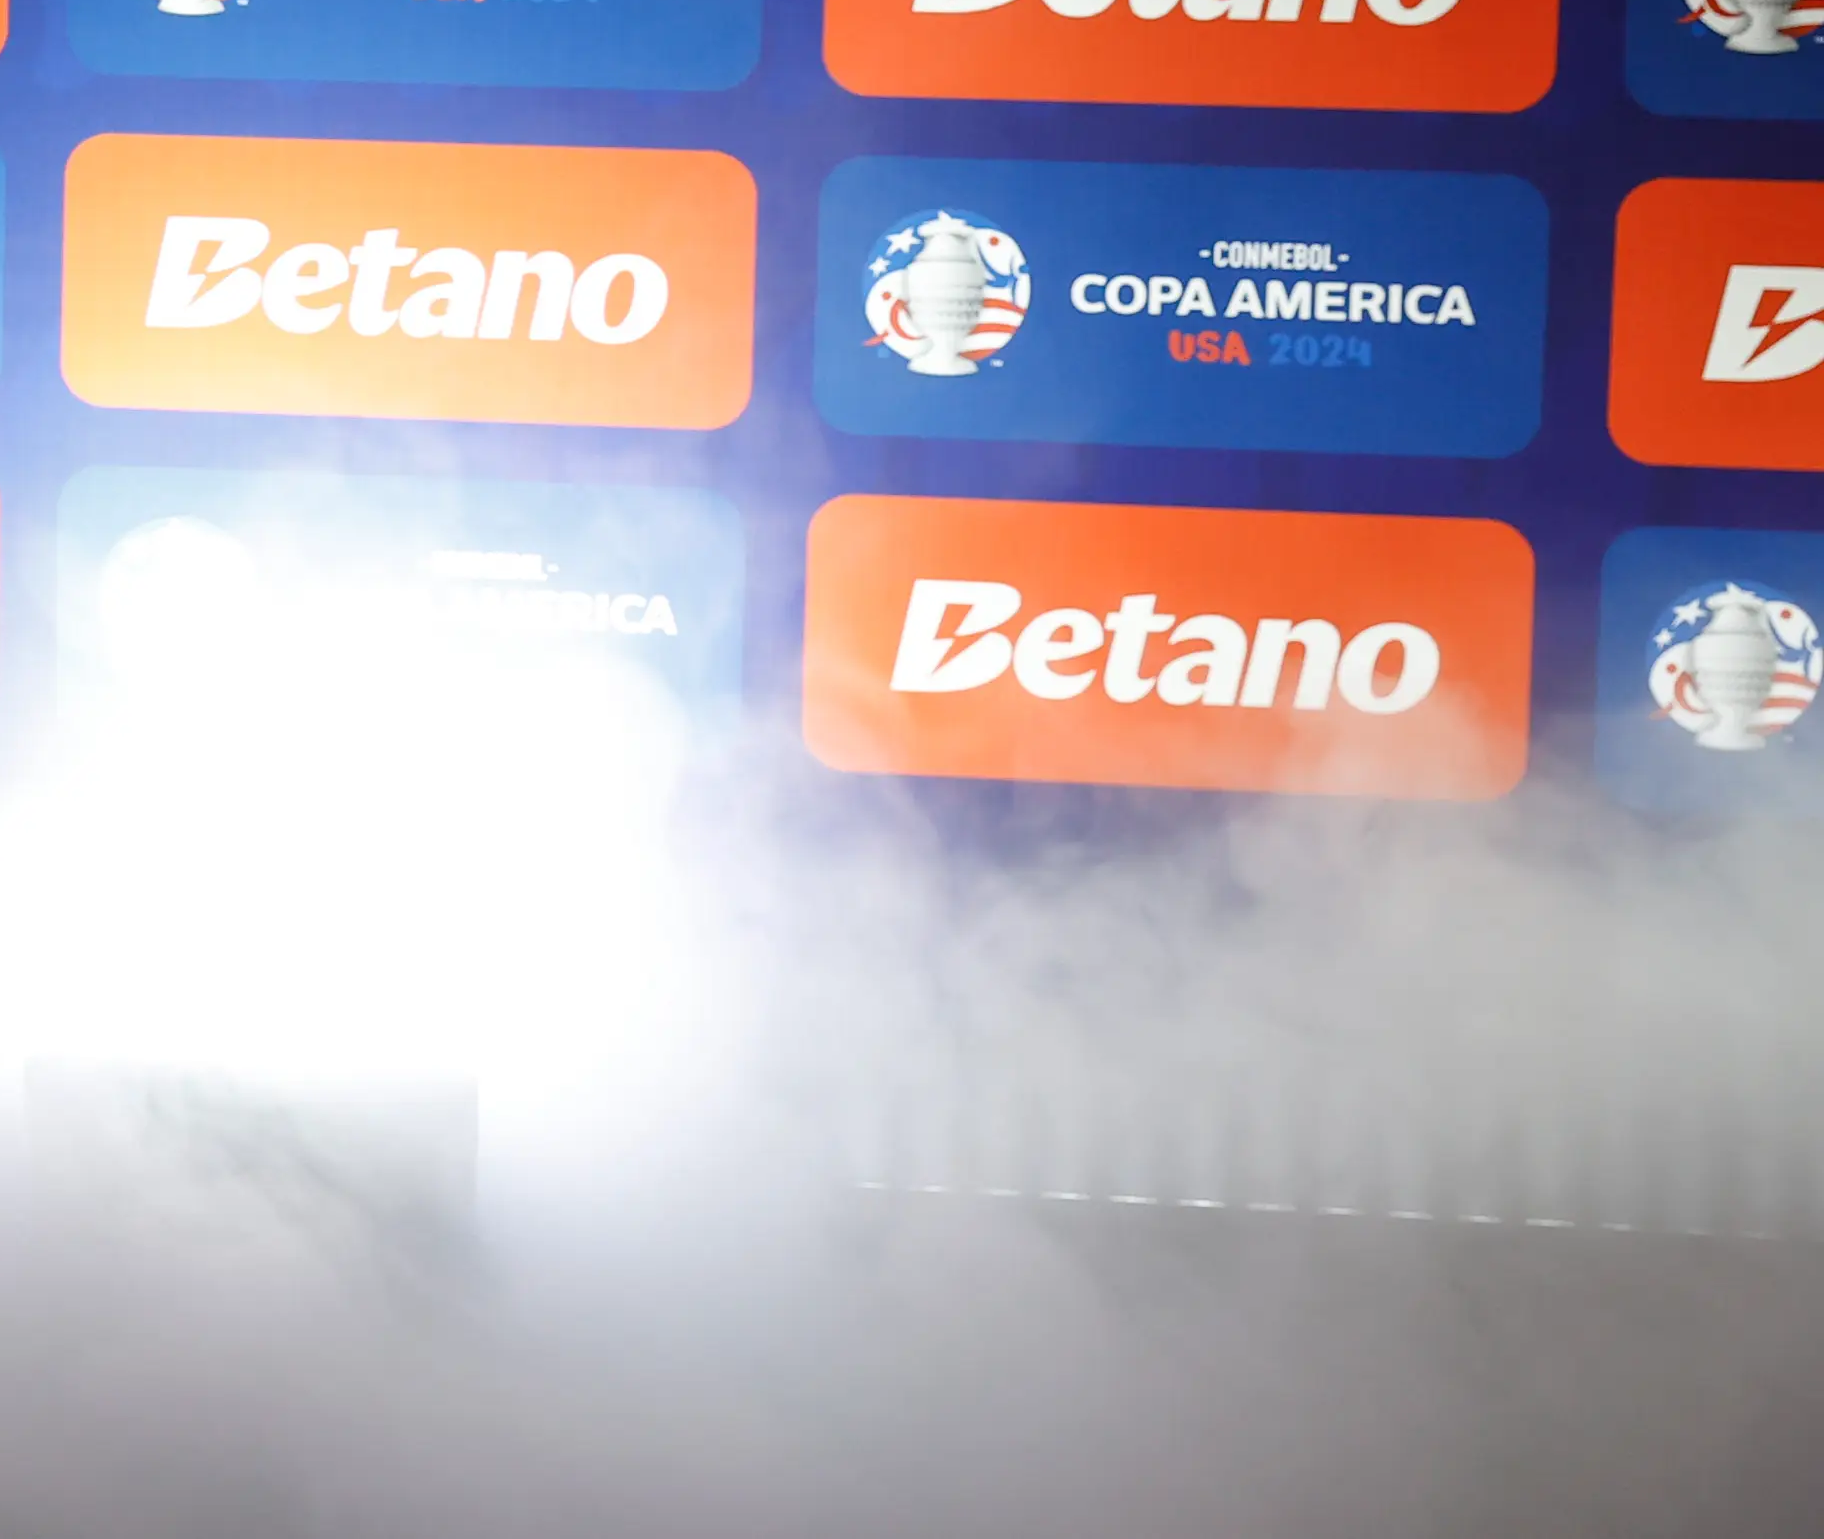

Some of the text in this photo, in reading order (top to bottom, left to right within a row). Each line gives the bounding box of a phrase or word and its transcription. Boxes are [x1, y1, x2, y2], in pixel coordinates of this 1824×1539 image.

[145, 216, 668, 344] Betano
[1071, 274, 1475, 325] COPA AMERICA
[1170, 332, 1371, 367] USA 2024
[889, 579, 1439, 716] Betano
